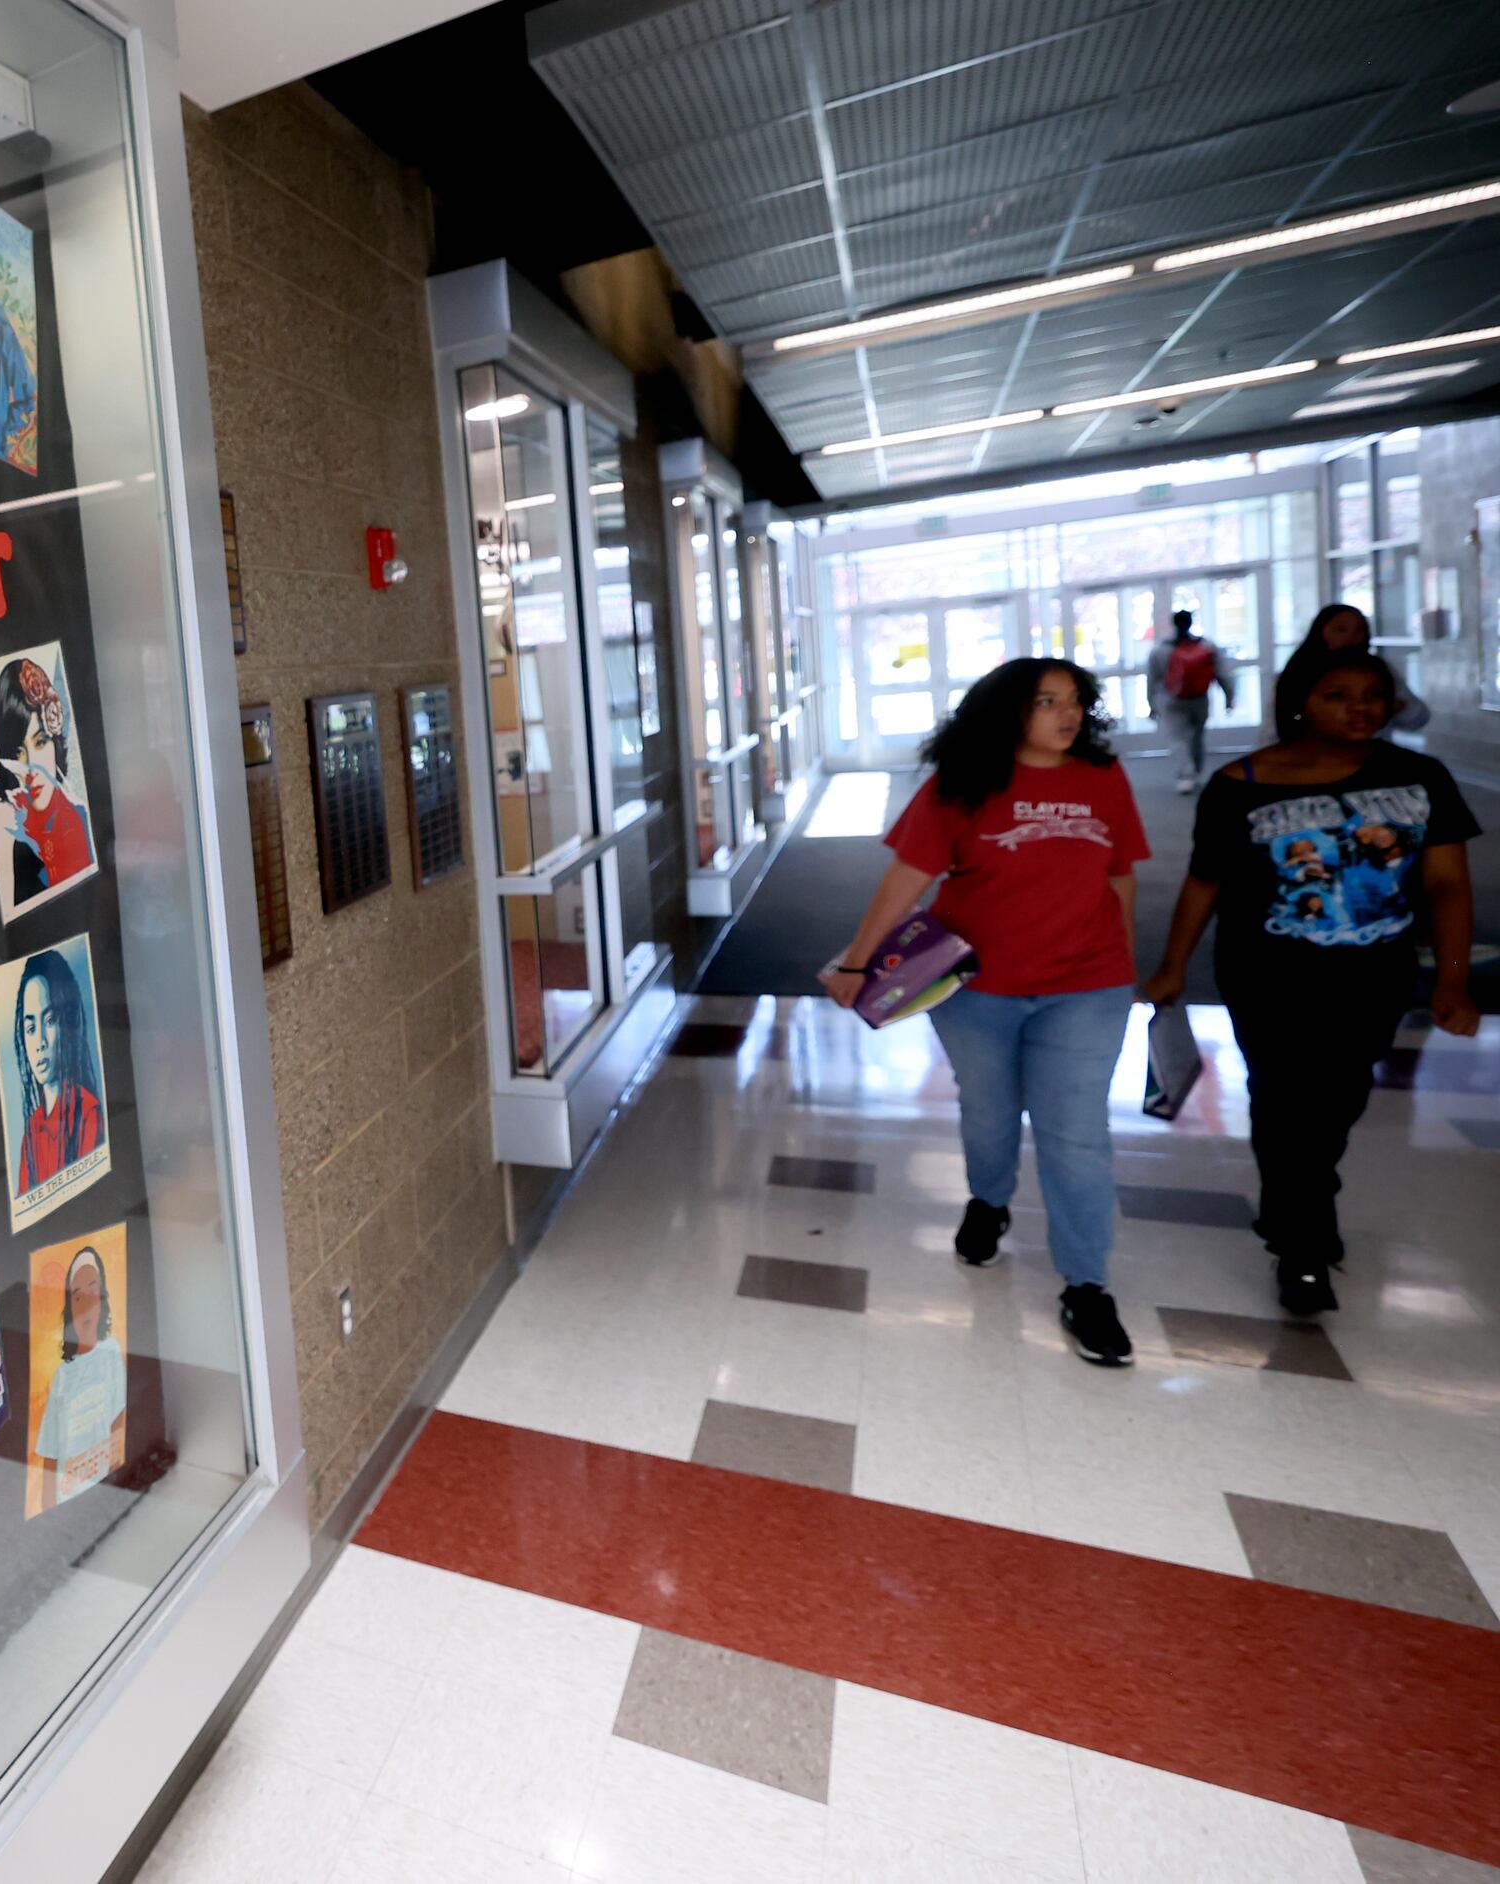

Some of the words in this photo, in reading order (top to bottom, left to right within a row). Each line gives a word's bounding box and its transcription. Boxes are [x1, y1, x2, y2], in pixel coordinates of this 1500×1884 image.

[1012, 800, 1093, 818] CLAYTON
[25, 1186, 45, 1206] WE
[45, 1173, 63, 1194] THE
[65, 1154, 101, 1181] PEOPLE
